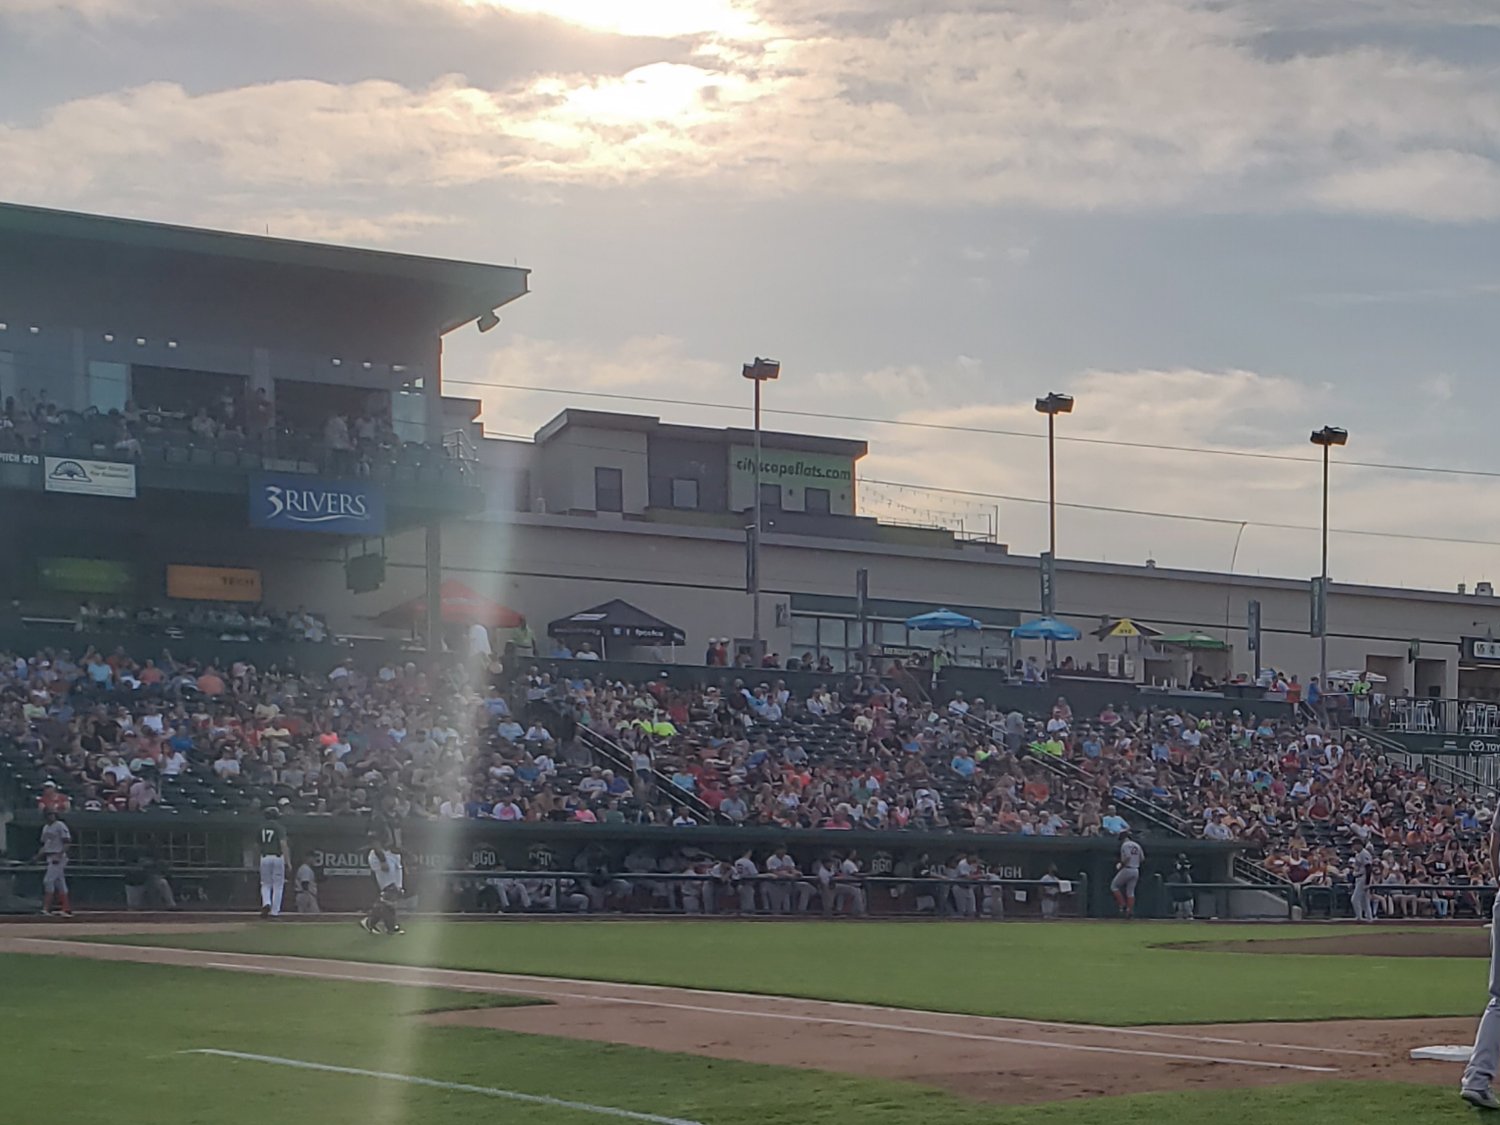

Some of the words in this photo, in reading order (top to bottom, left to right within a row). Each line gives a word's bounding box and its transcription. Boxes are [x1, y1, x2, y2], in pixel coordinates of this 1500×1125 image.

[265, 486, 283, 519] 3
[286, 490, 366, 515] RIVERS
[262, 828, 274, 843] 17
